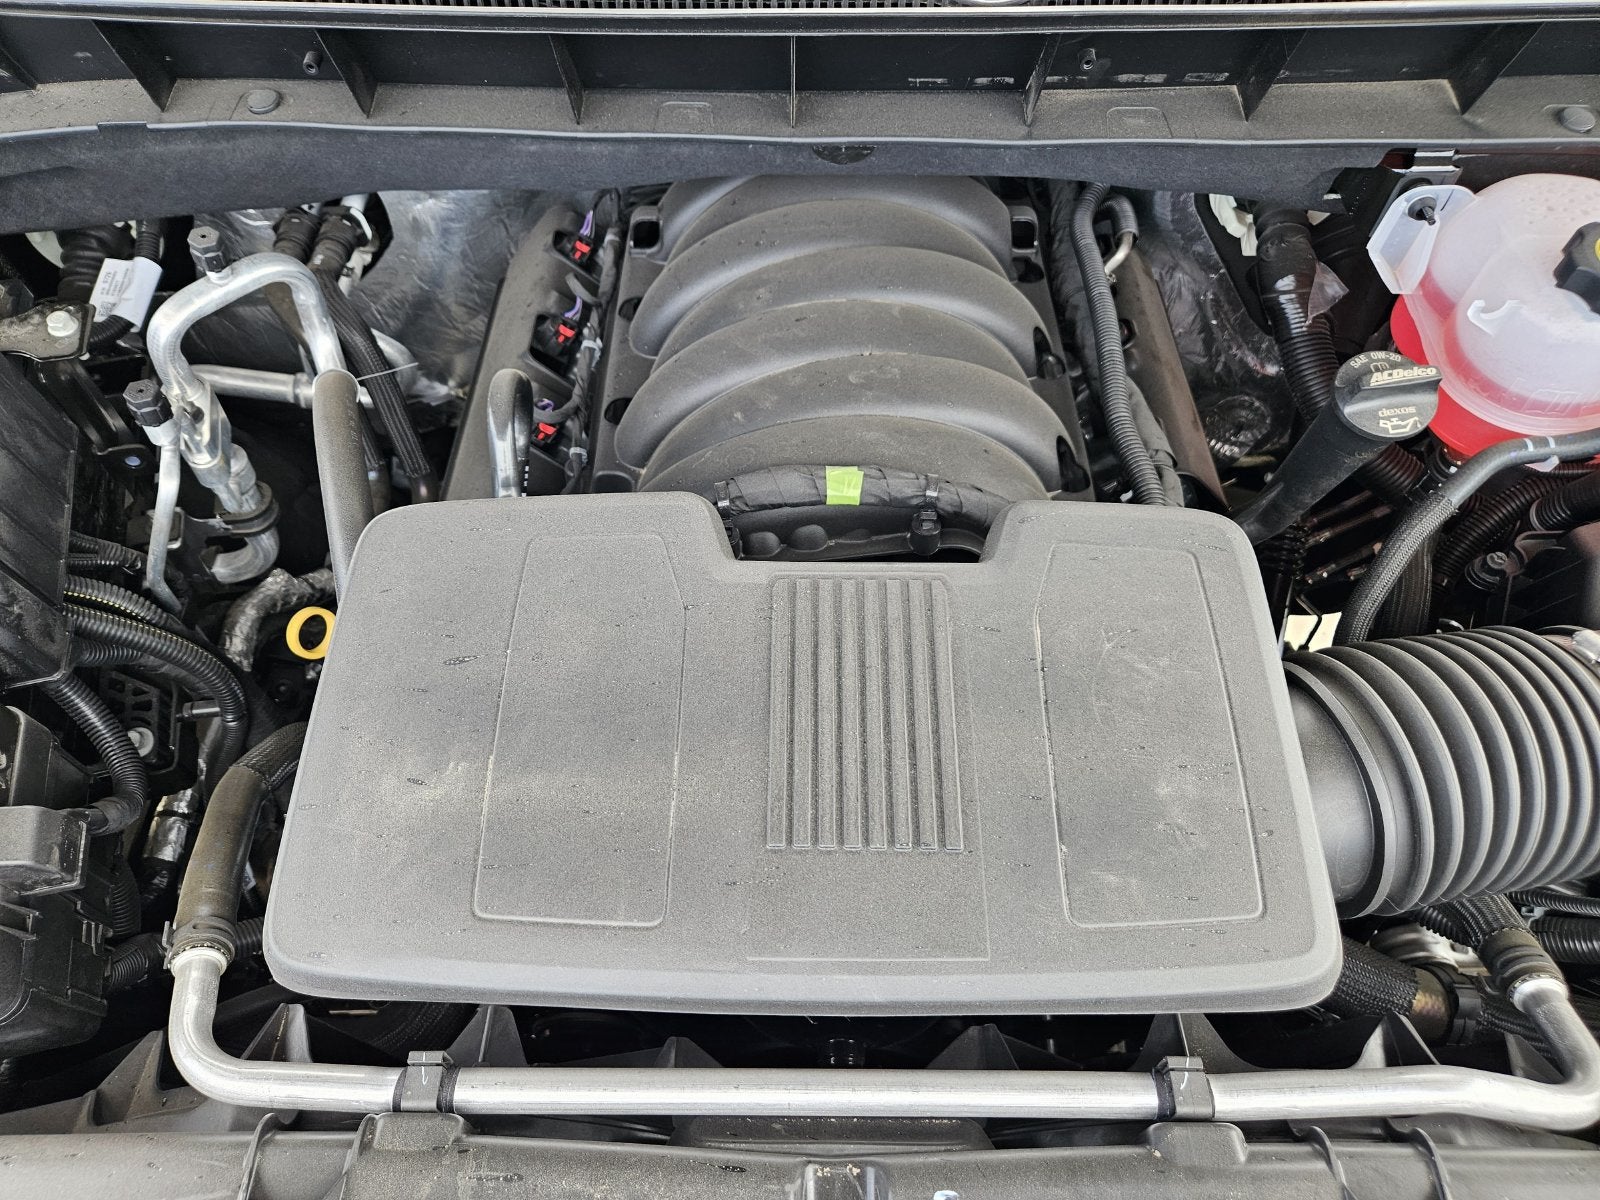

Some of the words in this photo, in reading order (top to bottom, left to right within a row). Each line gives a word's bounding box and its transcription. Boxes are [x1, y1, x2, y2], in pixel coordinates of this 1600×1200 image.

[1350, 354, 1369, 369] SAE
[1370, 351, 1402, 363] 0W-20
[1369, 366, 1437, 384] ACDelco
[1378, 405, 1417, 418] dexos
